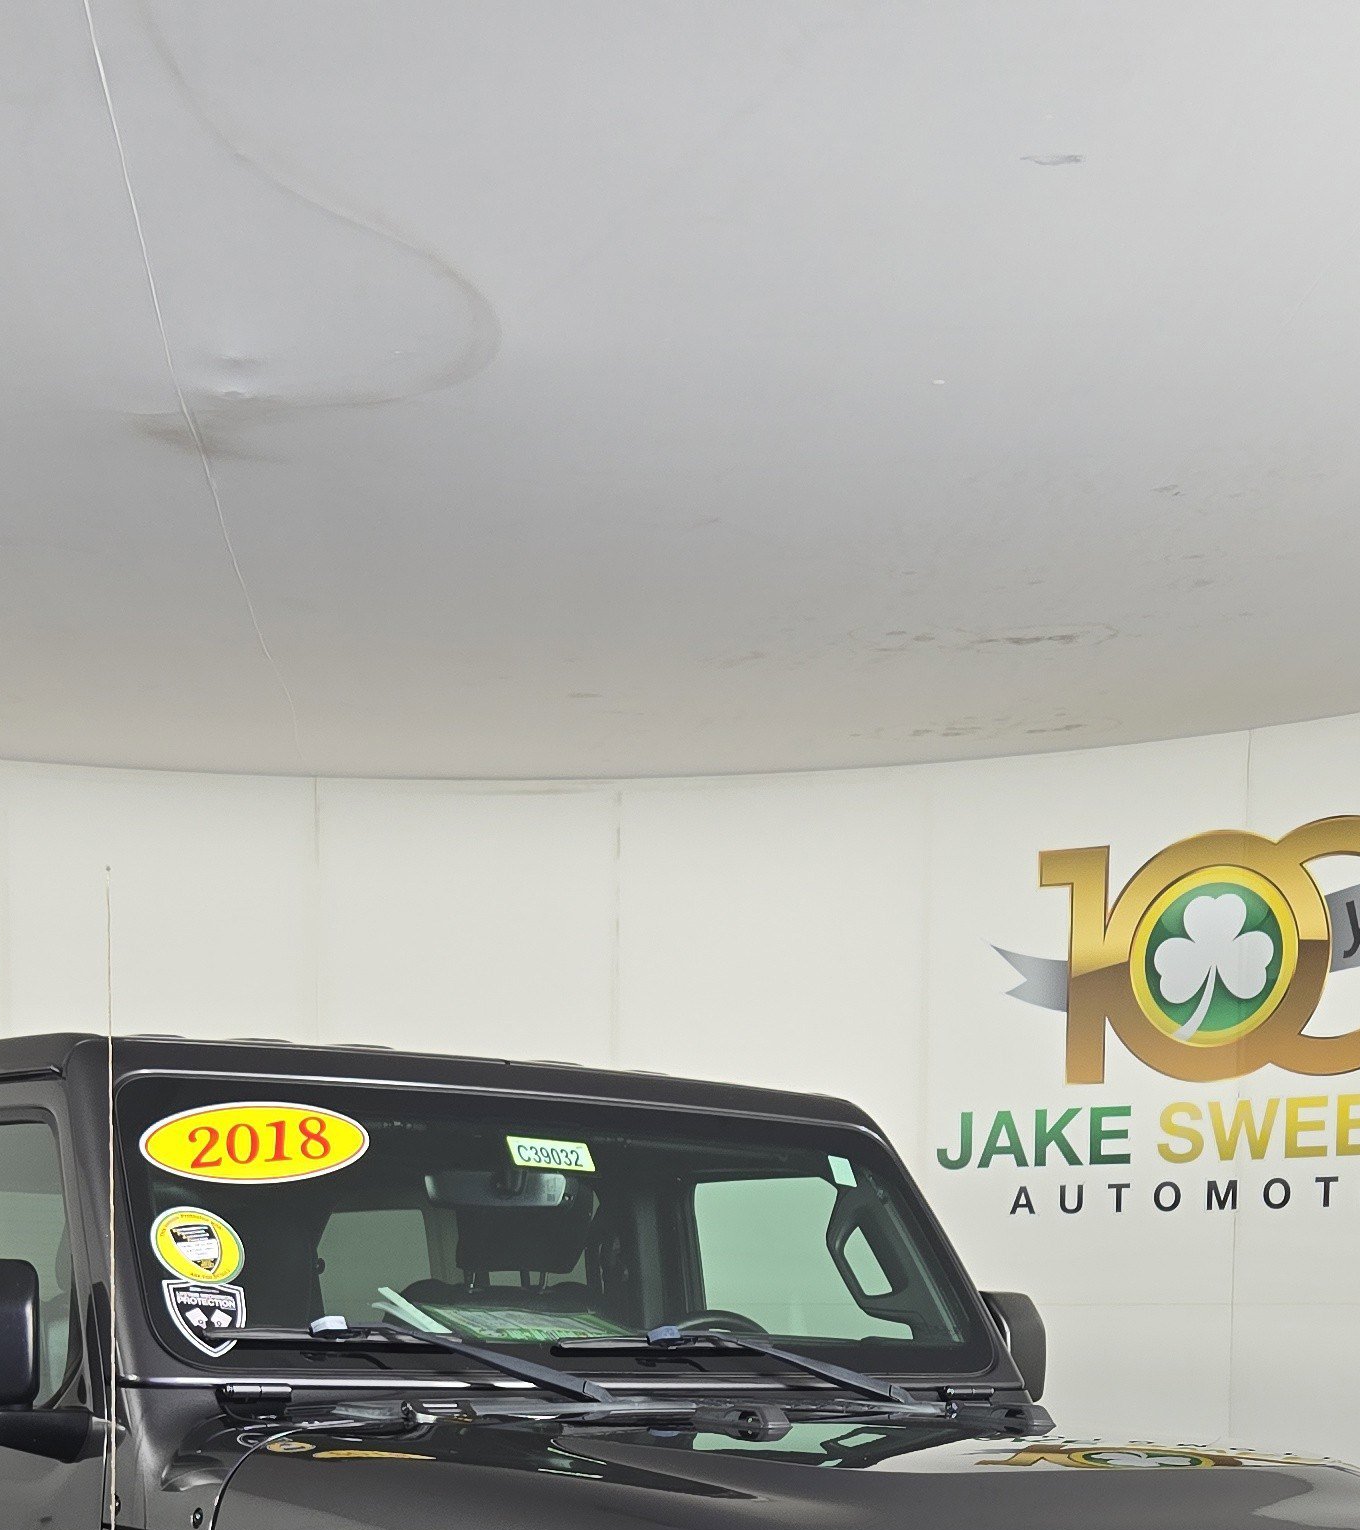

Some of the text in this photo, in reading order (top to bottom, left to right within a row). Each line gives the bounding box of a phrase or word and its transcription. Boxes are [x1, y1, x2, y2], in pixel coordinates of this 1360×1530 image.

[188, 1116, 331, 1169] 2018
[517, 1144, 584, 1168] C39032
[936, 1105, 1133, 1171] JAKE
